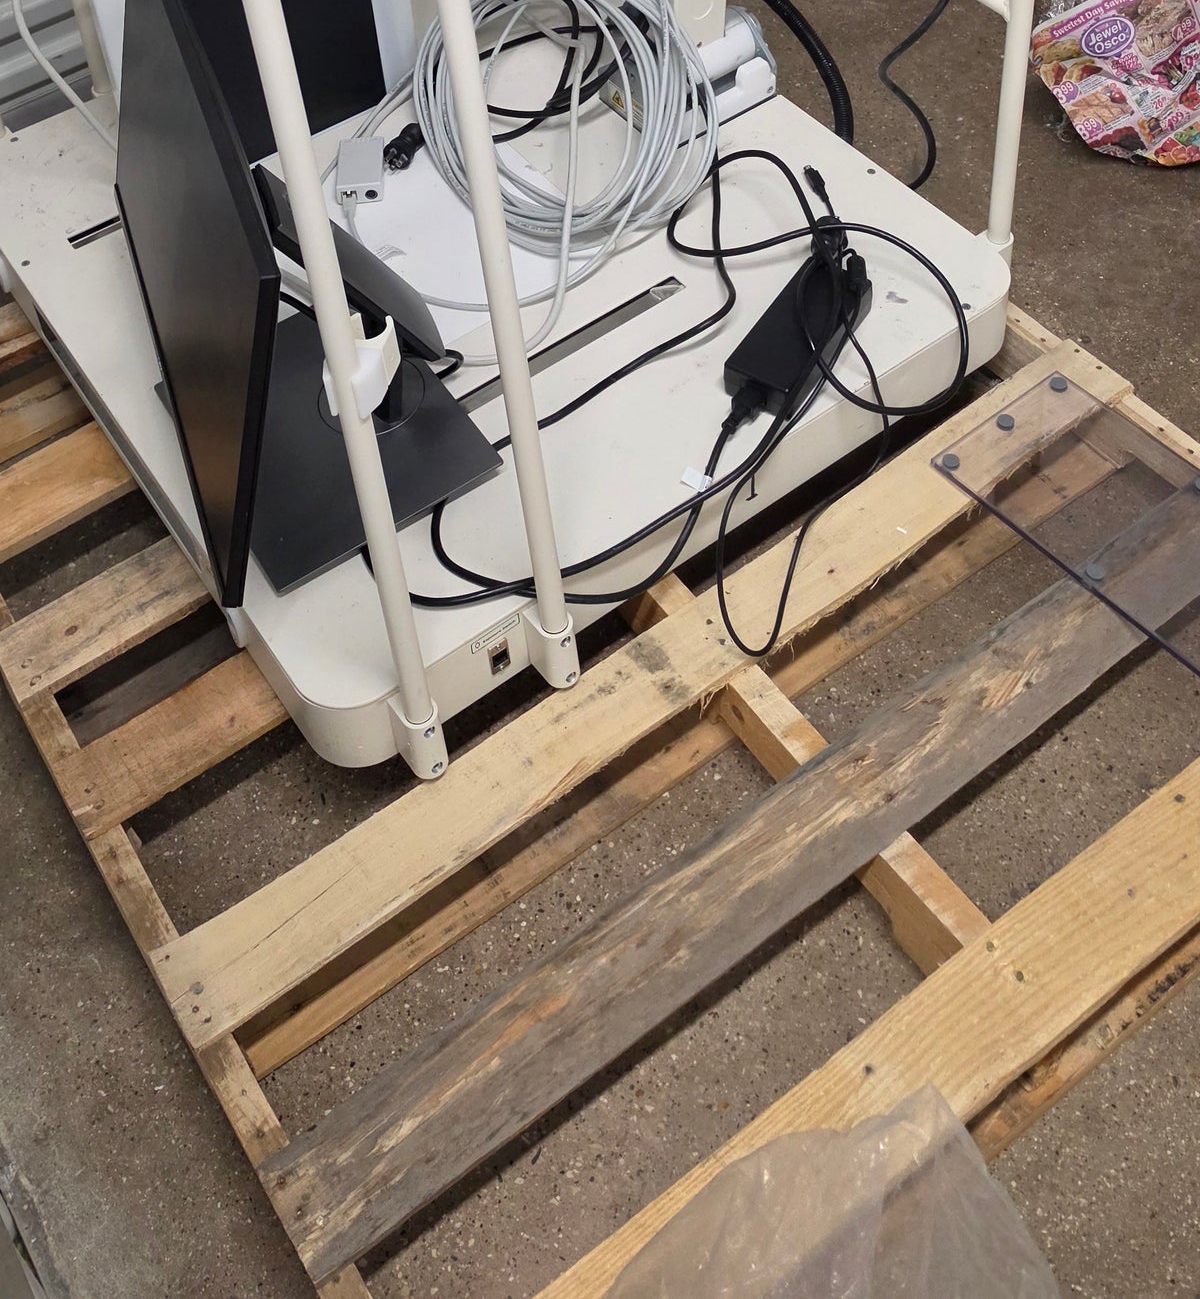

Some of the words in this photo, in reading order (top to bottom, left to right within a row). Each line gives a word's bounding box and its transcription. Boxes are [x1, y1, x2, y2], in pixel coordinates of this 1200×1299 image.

[1052, 15, 1085, 38] Sweetest
[1085, 6, 1104, 21] Day
[1088, 20, 1122, 46] Jewel
[1094, 33, 1126, 54] Osco
